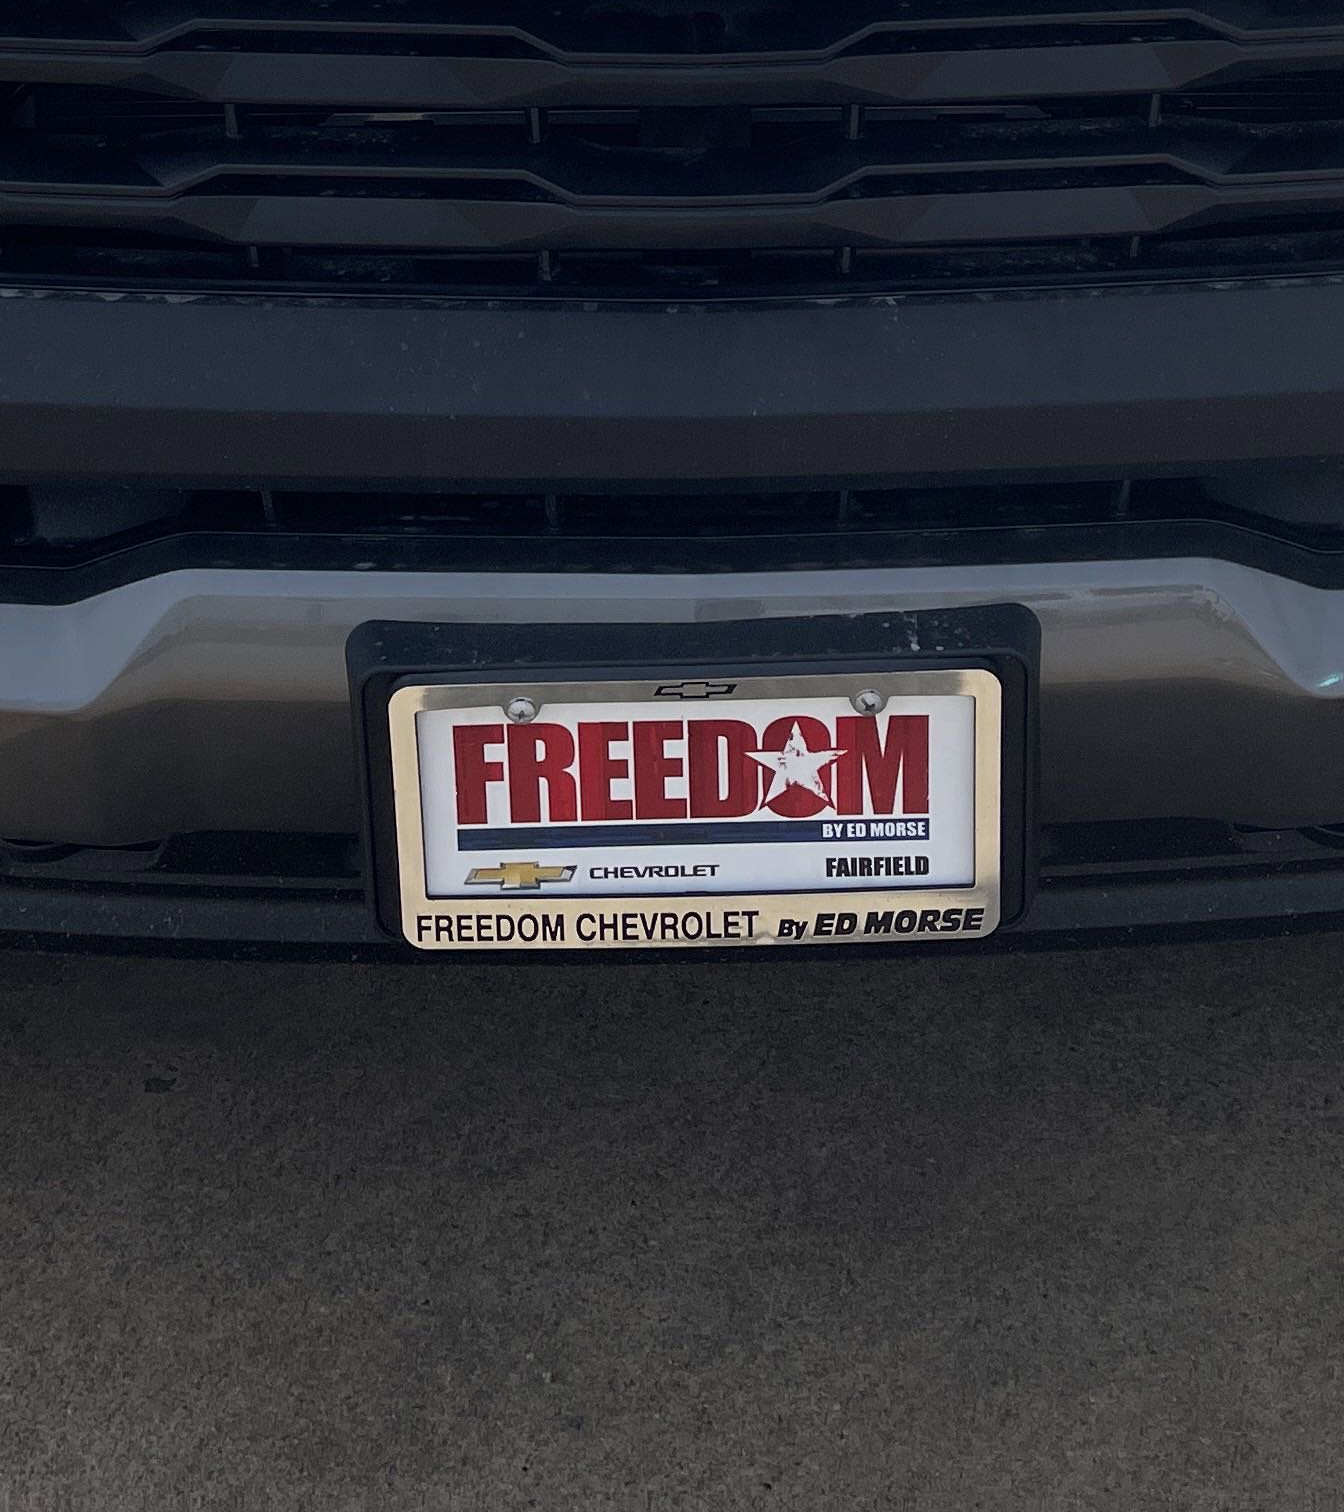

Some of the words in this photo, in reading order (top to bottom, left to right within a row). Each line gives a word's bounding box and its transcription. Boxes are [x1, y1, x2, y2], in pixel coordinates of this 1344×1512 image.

[452, 714, 930, 825] FREEDOM
[821, 822, 843, 839] BY
[846, 821, 867, 838] ED
[869, 820, 926, 838] MORSE
[589, 864, 720, 880] CHEVROLET
[825, 855, 930, 878] FAIRFIELD
[416, 913, 565, 942] FREEDOM
[575, 910, 759, 942] CHEVROLET
[777, 918, 809, 940] By
[813, 912, 858, 936] ED
[863, 907, 985, 935] MORSE
